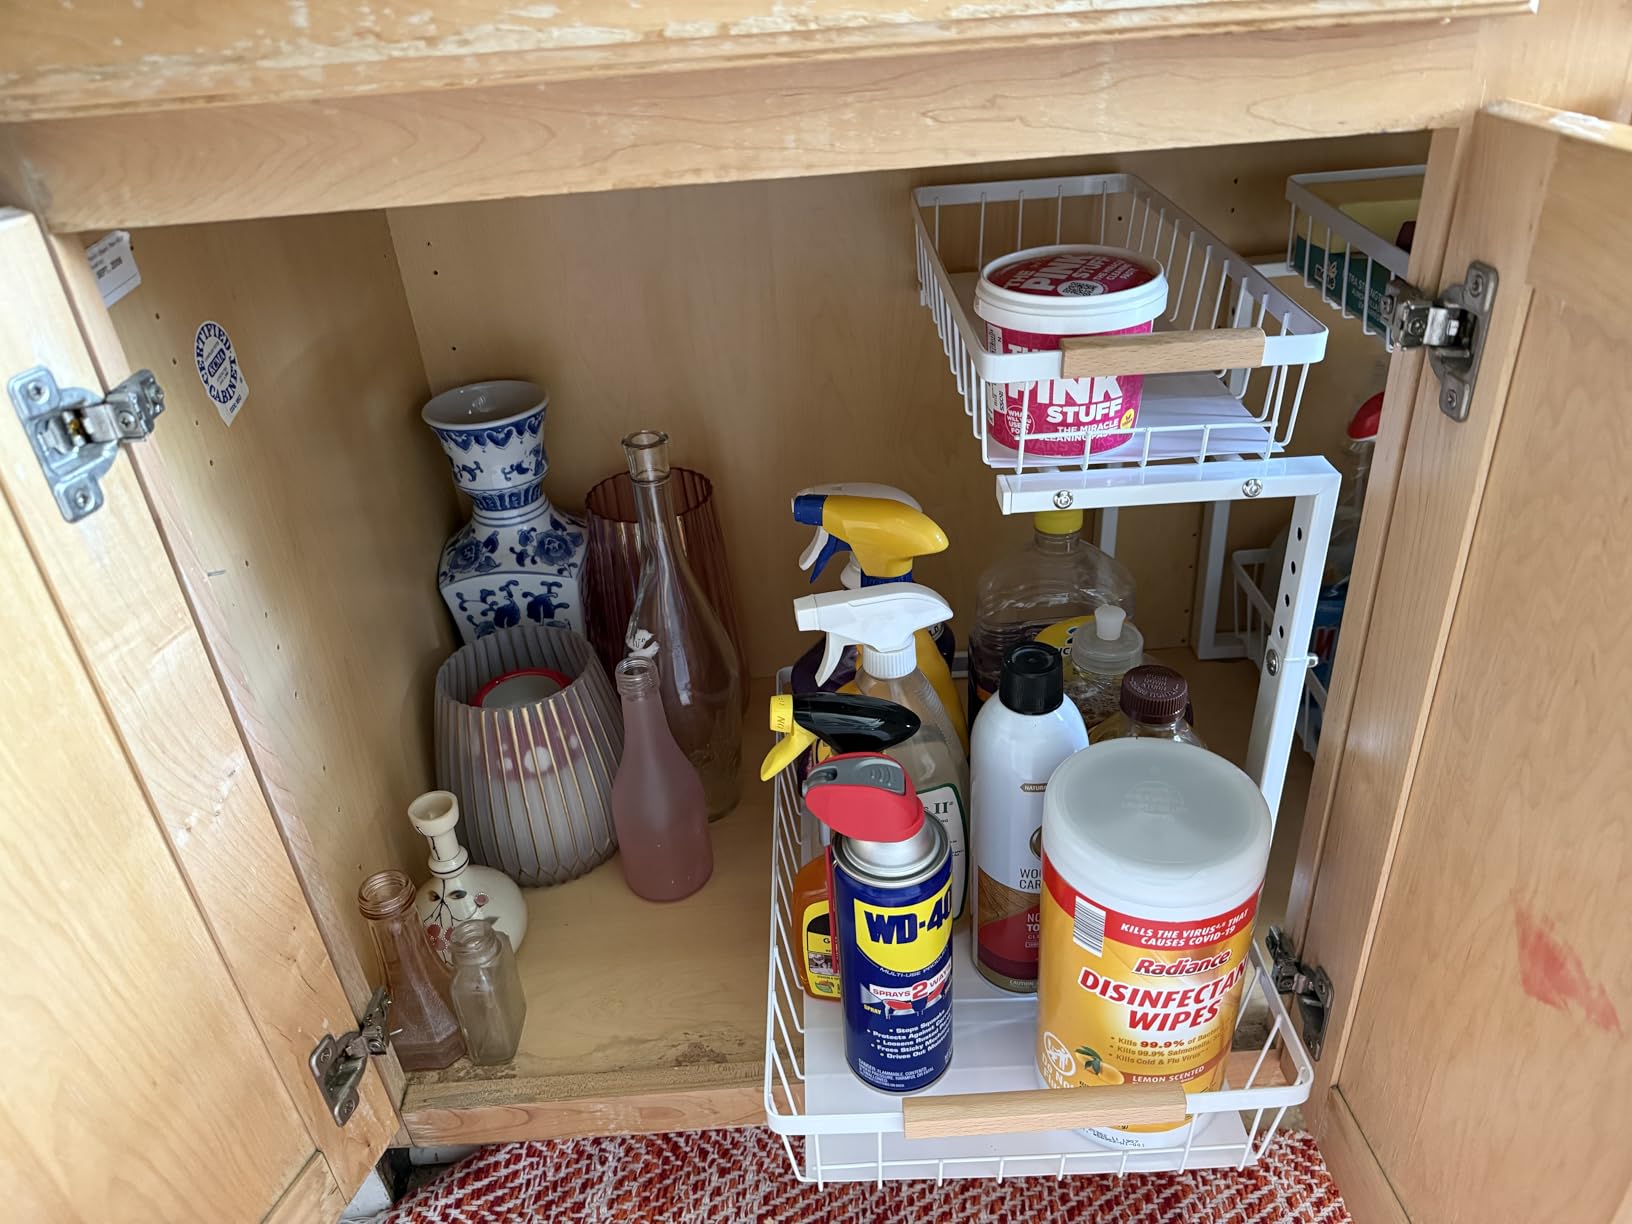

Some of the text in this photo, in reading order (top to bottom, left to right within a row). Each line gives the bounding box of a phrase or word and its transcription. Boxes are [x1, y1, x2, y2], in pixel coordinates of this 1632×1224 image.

[1003, 270, 1035, 289] THE
[1020, 254, 1095, 291] PINK
[196, 323, 231, 385] CERTIFIED
[209, 355, 237, 404] CABINET
[1008, 409, 1023, 418] WHA
[1046, 399, 1122, 423] STUFF
[1080, 418, 1119, 433] MIRACLE
[1020, 869, 1041, 879] WO
[1020, 880, 1041, 889] CAR
[864, 887, 952, 944] WD-40
[1121, 923, 1154, 937] KILLS
[1157, 930, 1179, 939] THE
[1228, 909, 1249, 927] THAT
[1027, 924, 1040, 932] TO
[1141, 925, 1236, 947] CAUSES COVID-19
[1134, 950, 1231, 976] Radiance
[880, 967, 921, 977] MULTI-USE
[873, 988, 910, 997] SPRAYS
[912, 981, 928, 1000] 2
[930, 963, 951, 987] WAYS
[1080, 957, 1249, 1009] DISINFECTAN
[1129, 999, 1220, 1032] WIPES
[873, 1031, 906, 1040] Protects
[908, 1024, 935, 1039] Against
[896, 1026, 919, 1034] Stops
[916, 1028, 939, 1043] Rusted
[877, 1043, 924, 1053] Frees Sticky
[1119, 1038, 1137, 1047] Kills
[1140, 1040, 1185, 1049] 99.9%
[1187, 1037, 1197, 1045] of
[1116, 1054, 1135, 1063] Kills
[1117, 1047, 1136, 1055] Kills
[1138, 1049, 1165, 1057] 99.9%
[1132, 1065, 1204, 1083] LEMON SCENTED
